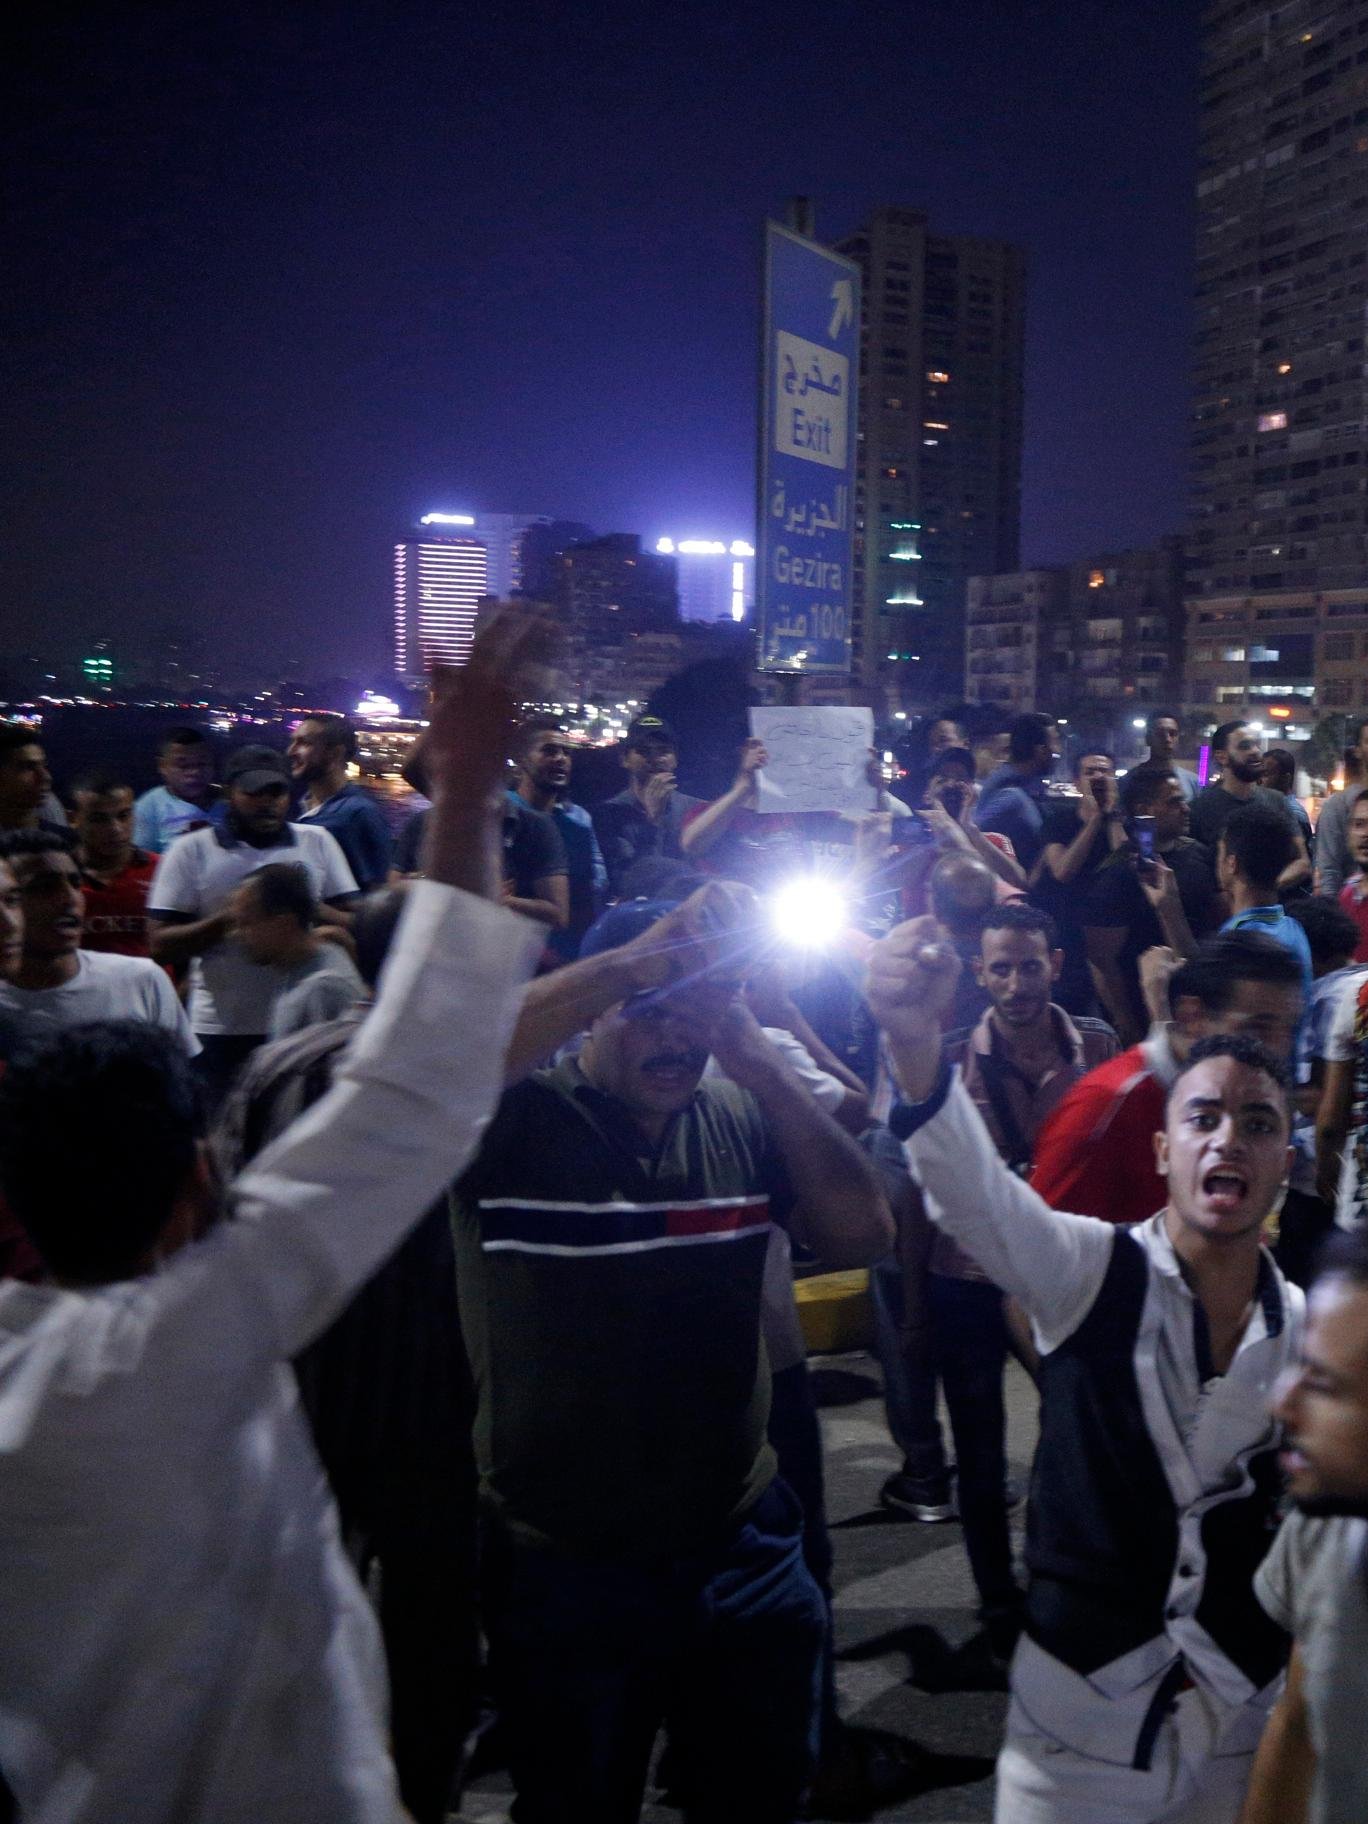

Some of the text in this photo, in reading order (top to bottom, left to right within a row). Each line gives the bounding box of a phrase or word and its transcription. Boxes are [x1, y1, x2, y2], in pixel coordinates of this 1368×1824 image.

[792, 407, 831, 455] Exit
[774, 544, 843, 592] Gezira
[809, 602, 846, 641] 100
